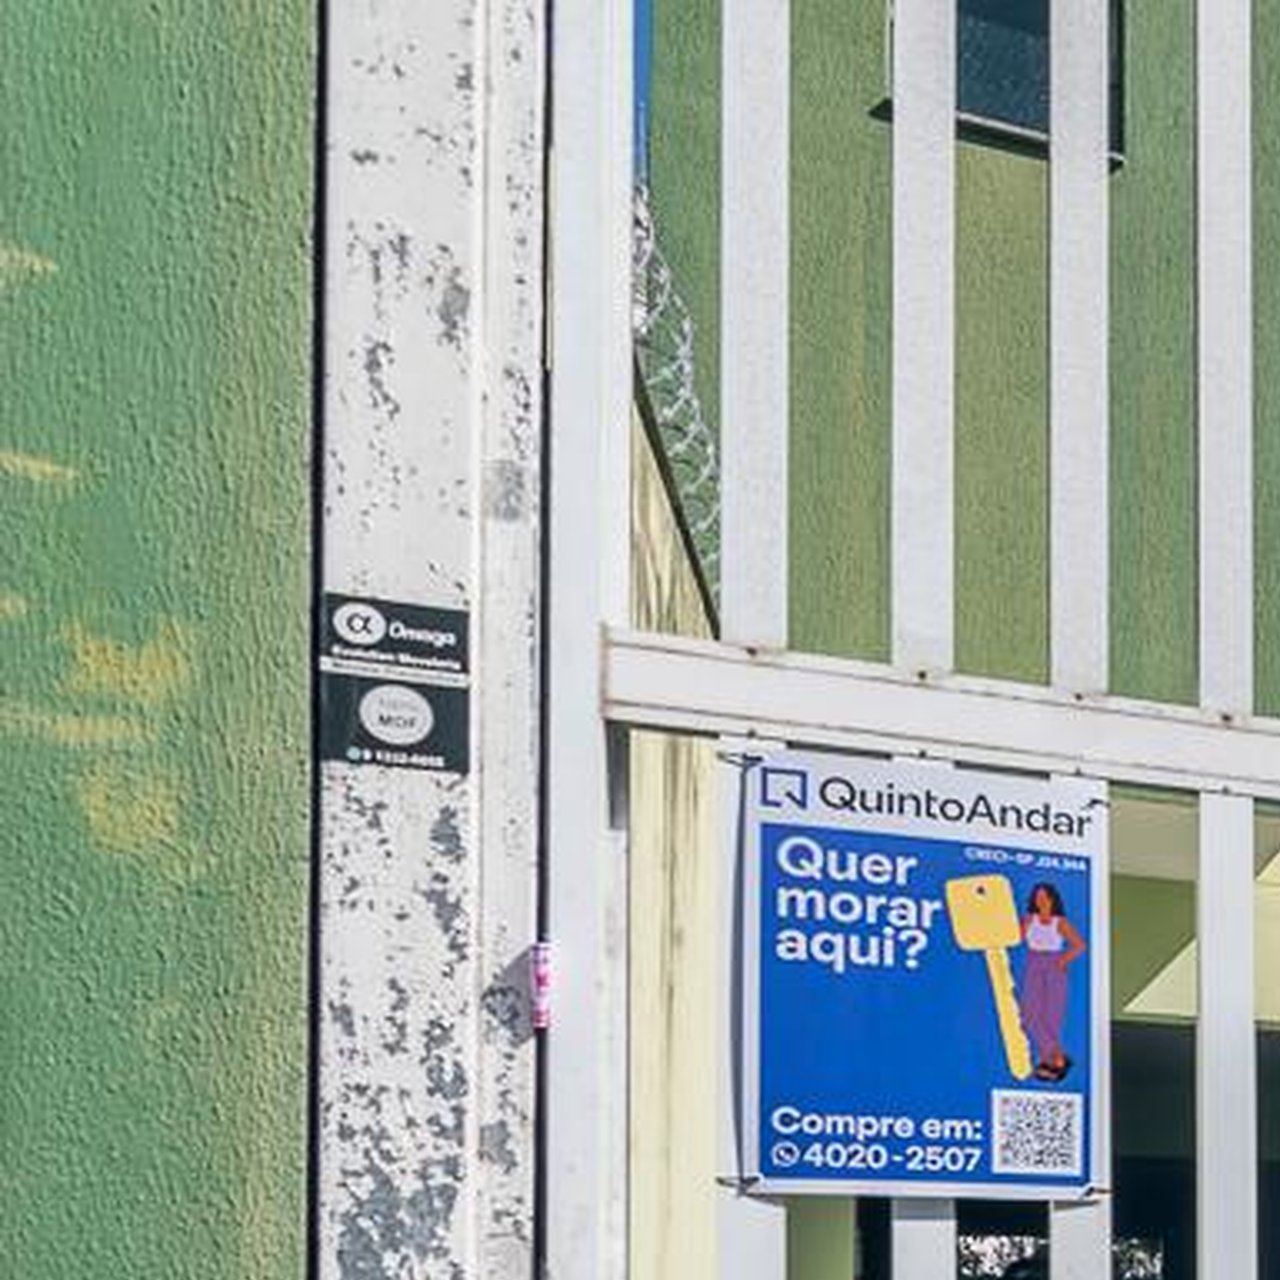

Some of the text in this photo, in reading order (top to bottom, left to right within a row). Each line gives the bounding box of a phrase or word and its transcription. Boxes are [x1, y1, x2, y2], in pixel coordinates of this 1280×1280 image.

[818, 776, 1092, 838] QuintoAndar
[776, 836, 917, 886] Quer
[776, 885, 942, 929] morar
[775, 927, 928, 973] aqui?
[771, 1105, 983, 1141] Compre em:
